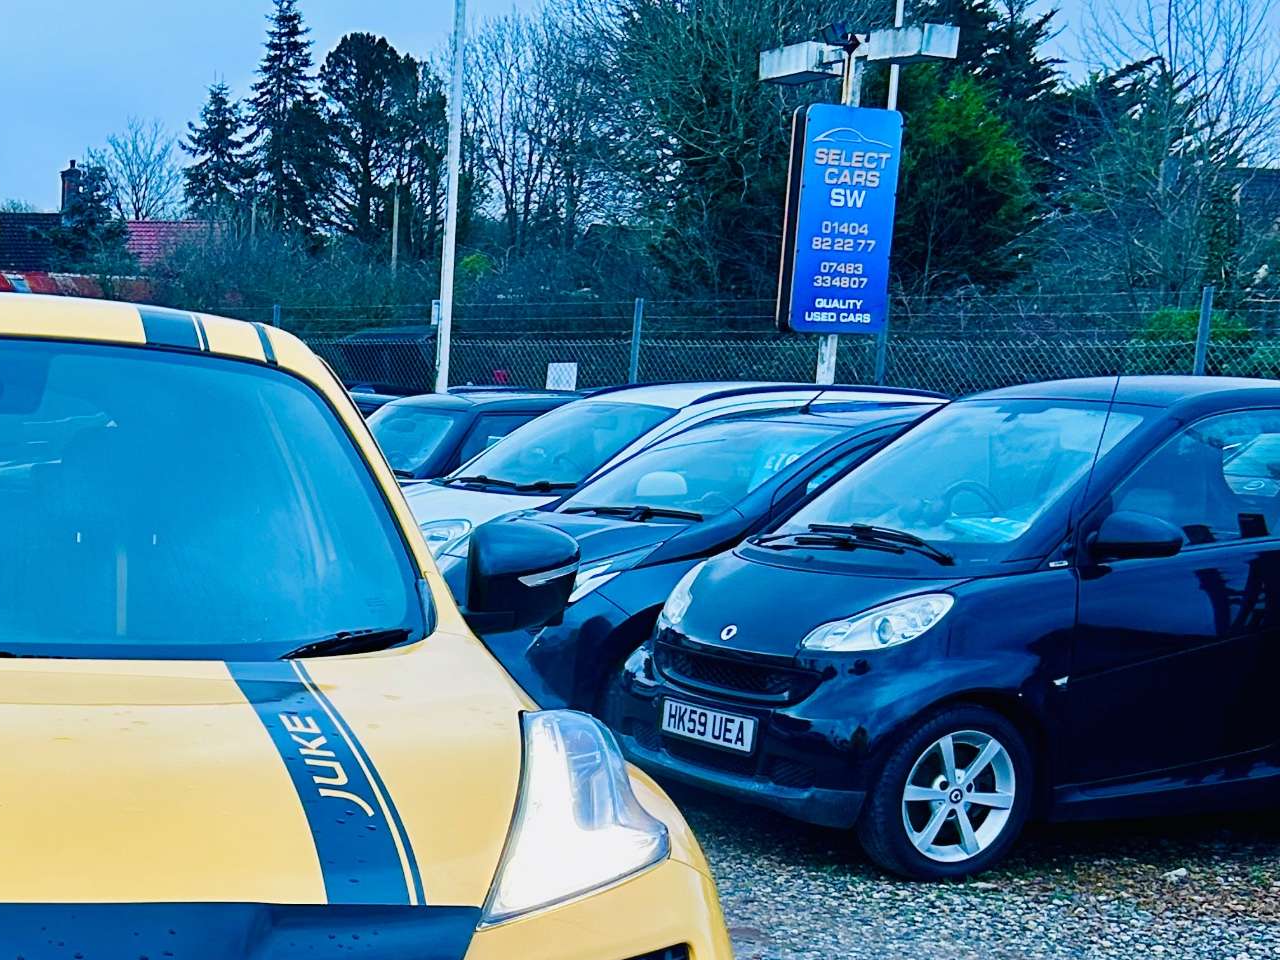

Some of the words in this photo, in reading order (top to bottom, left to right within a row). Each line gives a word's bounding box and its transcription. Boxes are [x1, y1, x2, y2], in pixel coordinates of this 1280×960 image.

[814, 148, 891, 169] SELECT
[824, 168, 880, 187] CARS
[830, 188, 866, 208] SW
[821, 221, 869, 236] 01404
[820, 262, 863, 274] 07483
[813, 275, 868, 289] 334807
[814, 298, 864, 310] QUALITY
[804, 311, 837, 323] USED
[839, 312, 871, 324] CARS
[667, 703, 708, 737] HK59
[711, 714, 745, 747] UEA
[278, 713, 375, 817] JUKE
